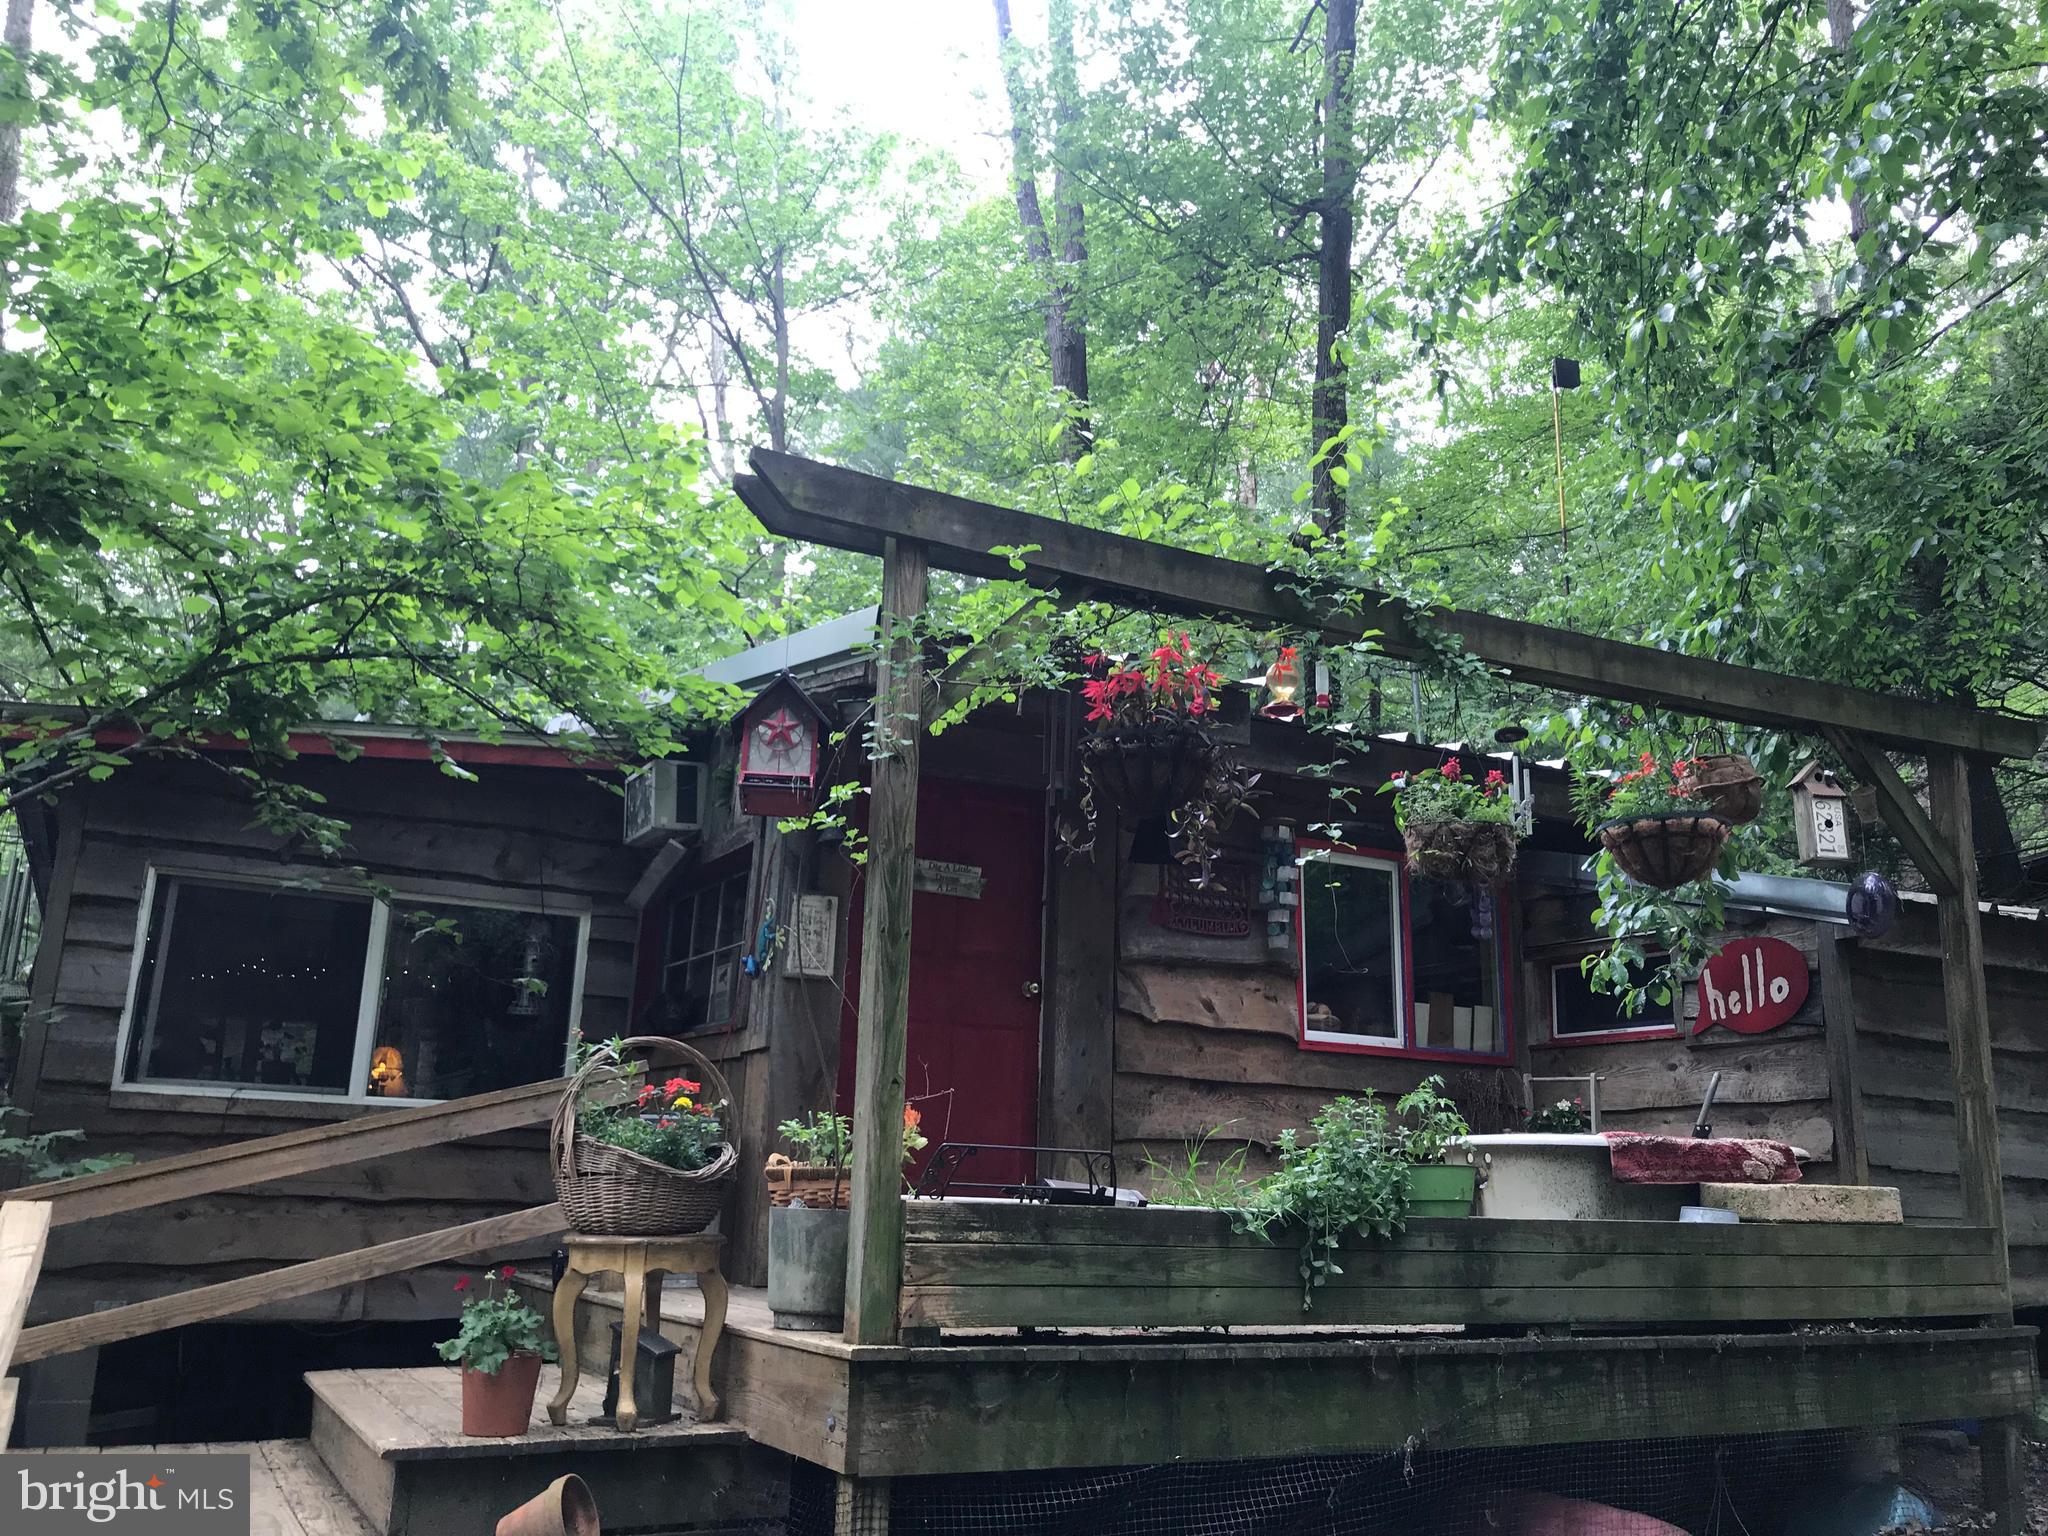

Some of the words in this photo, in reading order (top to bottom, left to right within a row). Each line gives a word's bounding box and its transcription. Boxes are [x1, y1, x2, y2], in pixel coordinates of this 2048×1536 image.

[1815, 800, 1837, 856] 62321
[1834, 806, 1842, 827] USA
[943, 863, 951, 874] A
[1703, 946, 1790, 1021] hello
